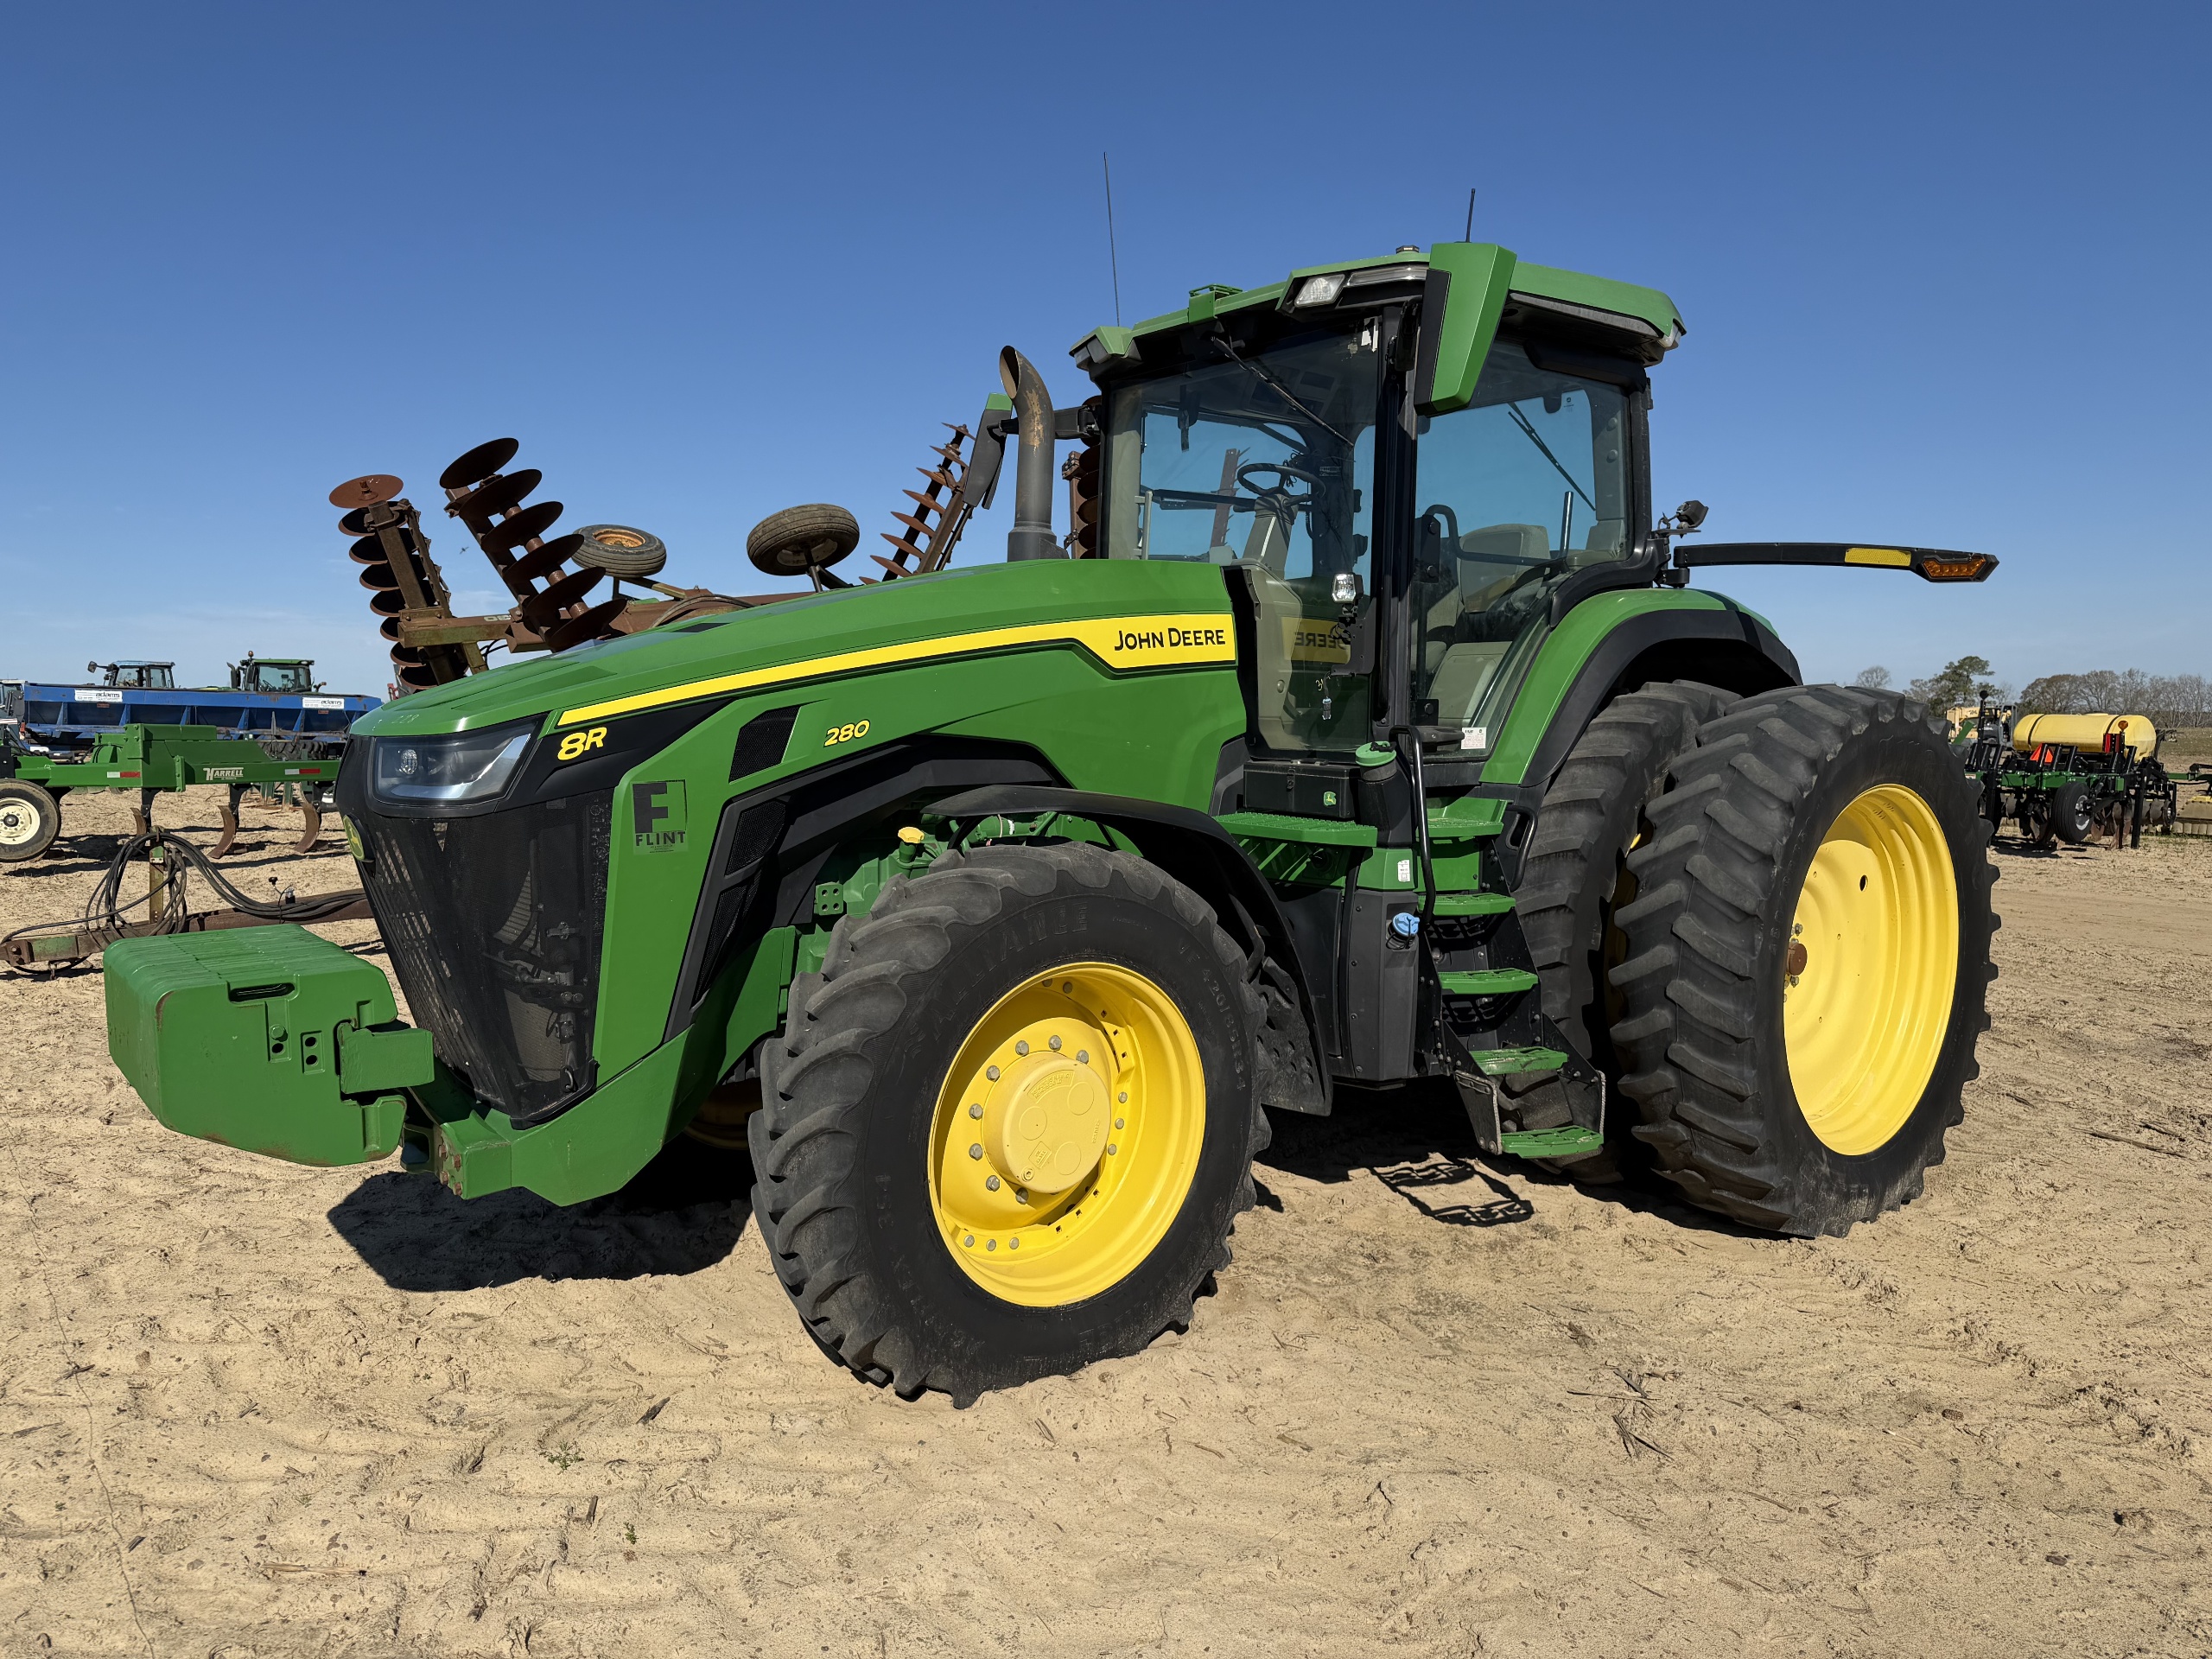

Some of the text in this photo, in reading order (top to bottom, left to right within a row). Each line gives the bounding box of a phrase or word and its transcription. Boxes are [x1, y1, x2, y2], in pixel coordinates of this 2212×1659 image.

[1114, 627, 1226, 652] JOHN DEERE
[557, 726, 607, 761] 8R
[823, 718, 871, 748] 280
[202, 766, 245, 781] HARRELL
[635, 830, 686, 847] FLINT
